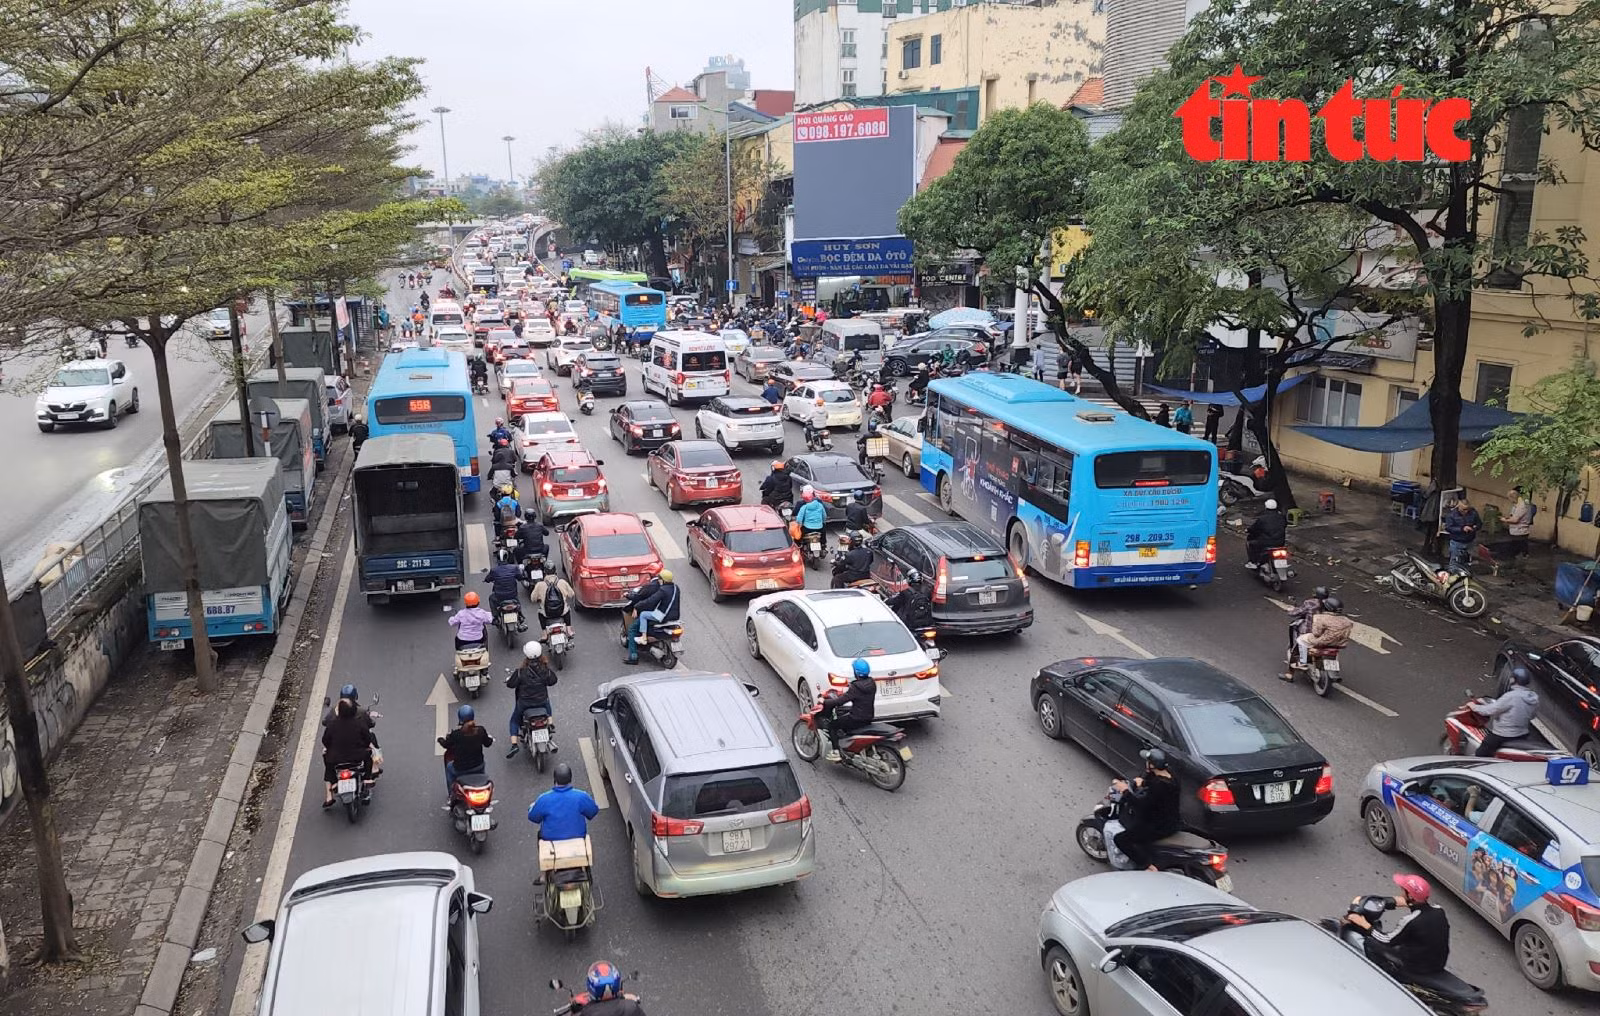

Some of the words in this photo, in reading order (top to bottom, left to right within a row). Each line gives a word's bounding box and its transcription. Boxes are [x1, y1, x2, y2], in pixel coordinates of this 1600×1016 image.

[823, 243, 851, 251] HUY
[867, 252, 882, 262] DA
[939, 273, 967, 281] CENTRE
[1560, 764, 1582, 784] G7
[1269, 783, 1284, 793] 29Z
[1438, 841, 1459, 863] TAXI
